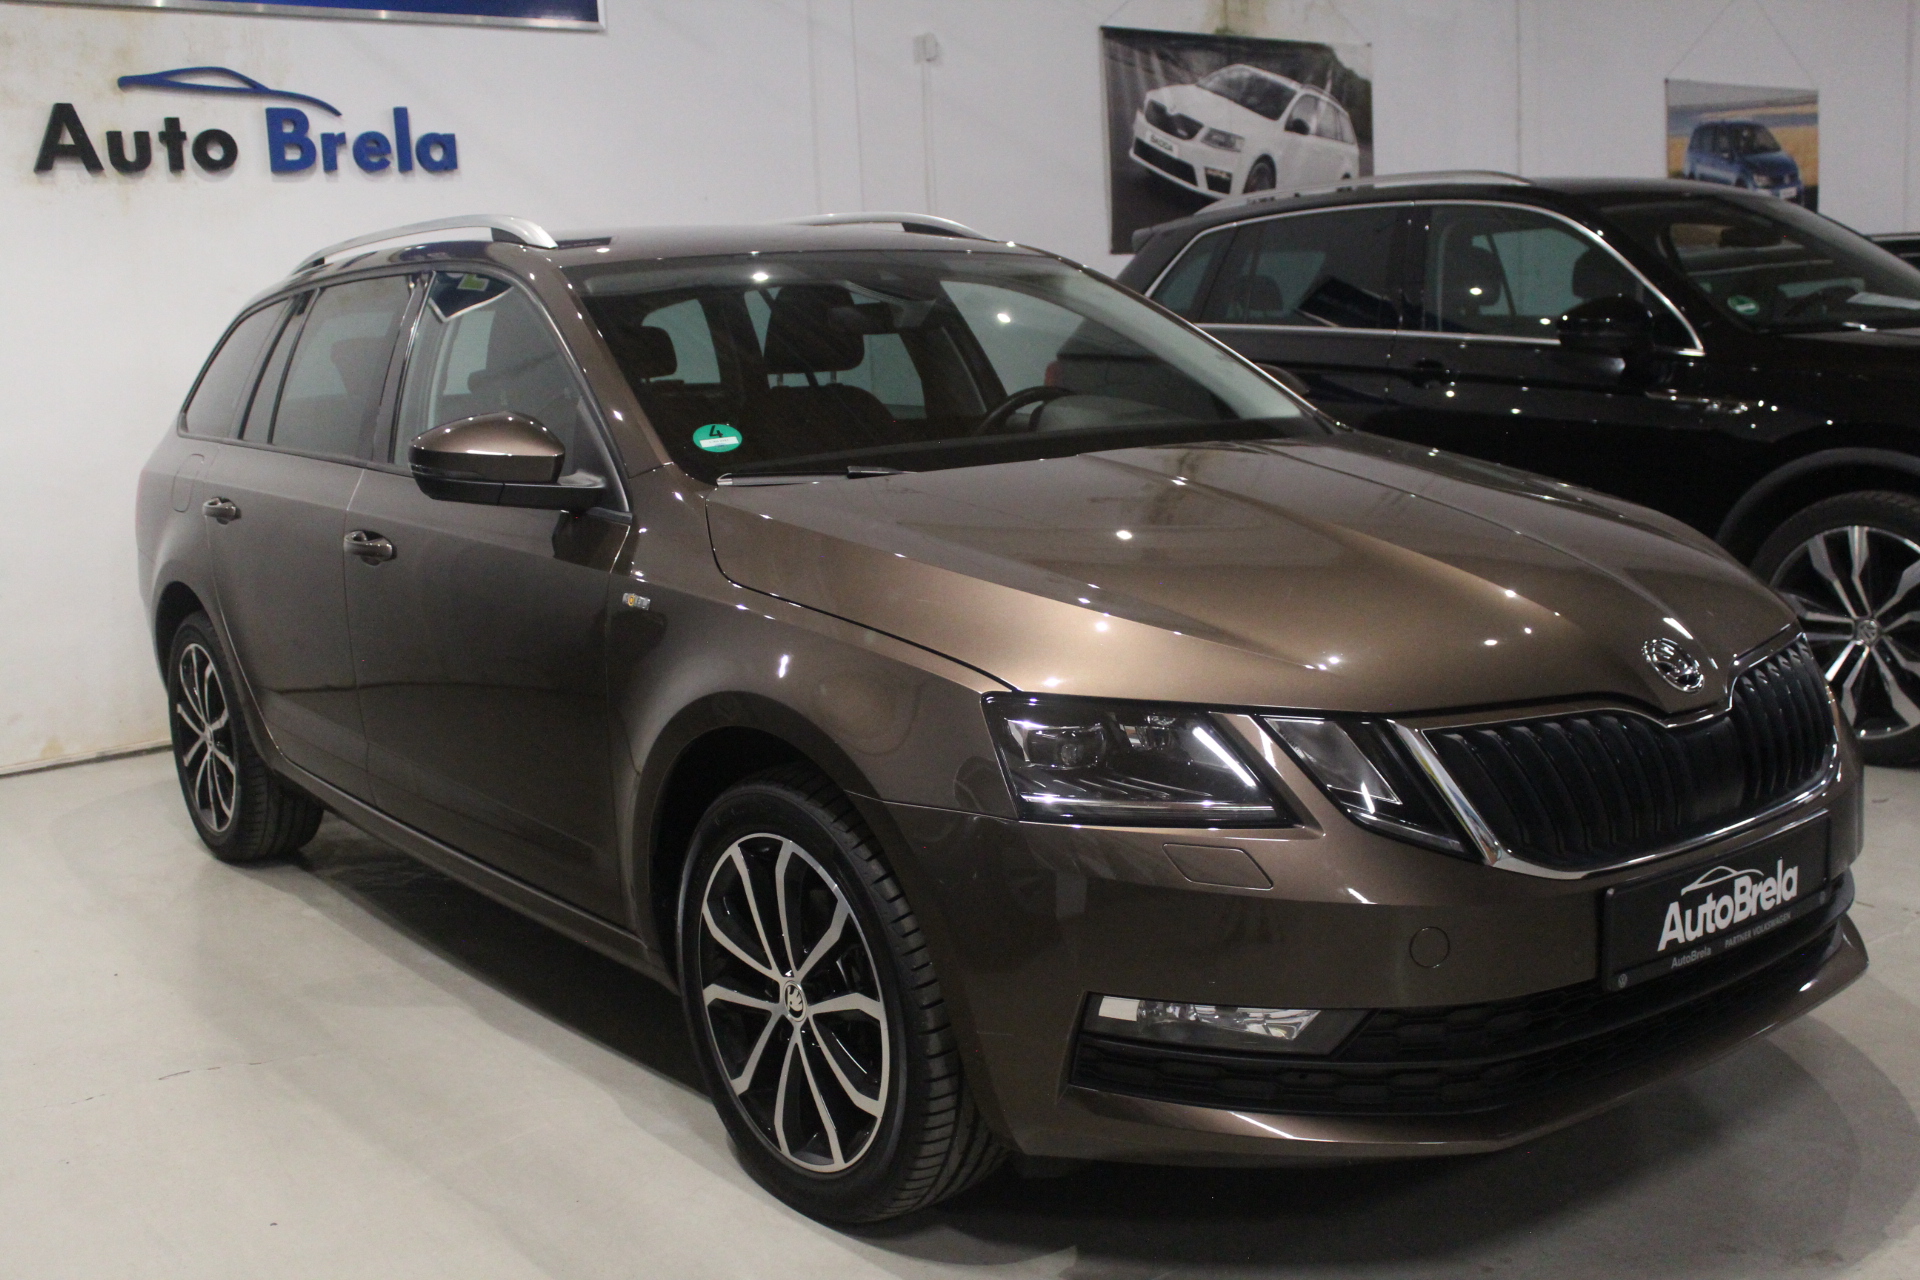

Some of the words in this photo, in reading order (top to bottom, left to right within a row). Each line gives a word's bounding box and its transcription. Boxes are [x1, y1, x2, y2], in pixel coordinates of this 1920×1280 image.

[34, 102, 238, 174] Auto
[265, 106, 458, 173] Brela
[709, 424, 723, 438] 4
[1657, 859, 1798, 951] AutoBrela
[1724, 930, 1752, 949] PARTNER
[1671, 946, 1711, 969] AutoBrela
